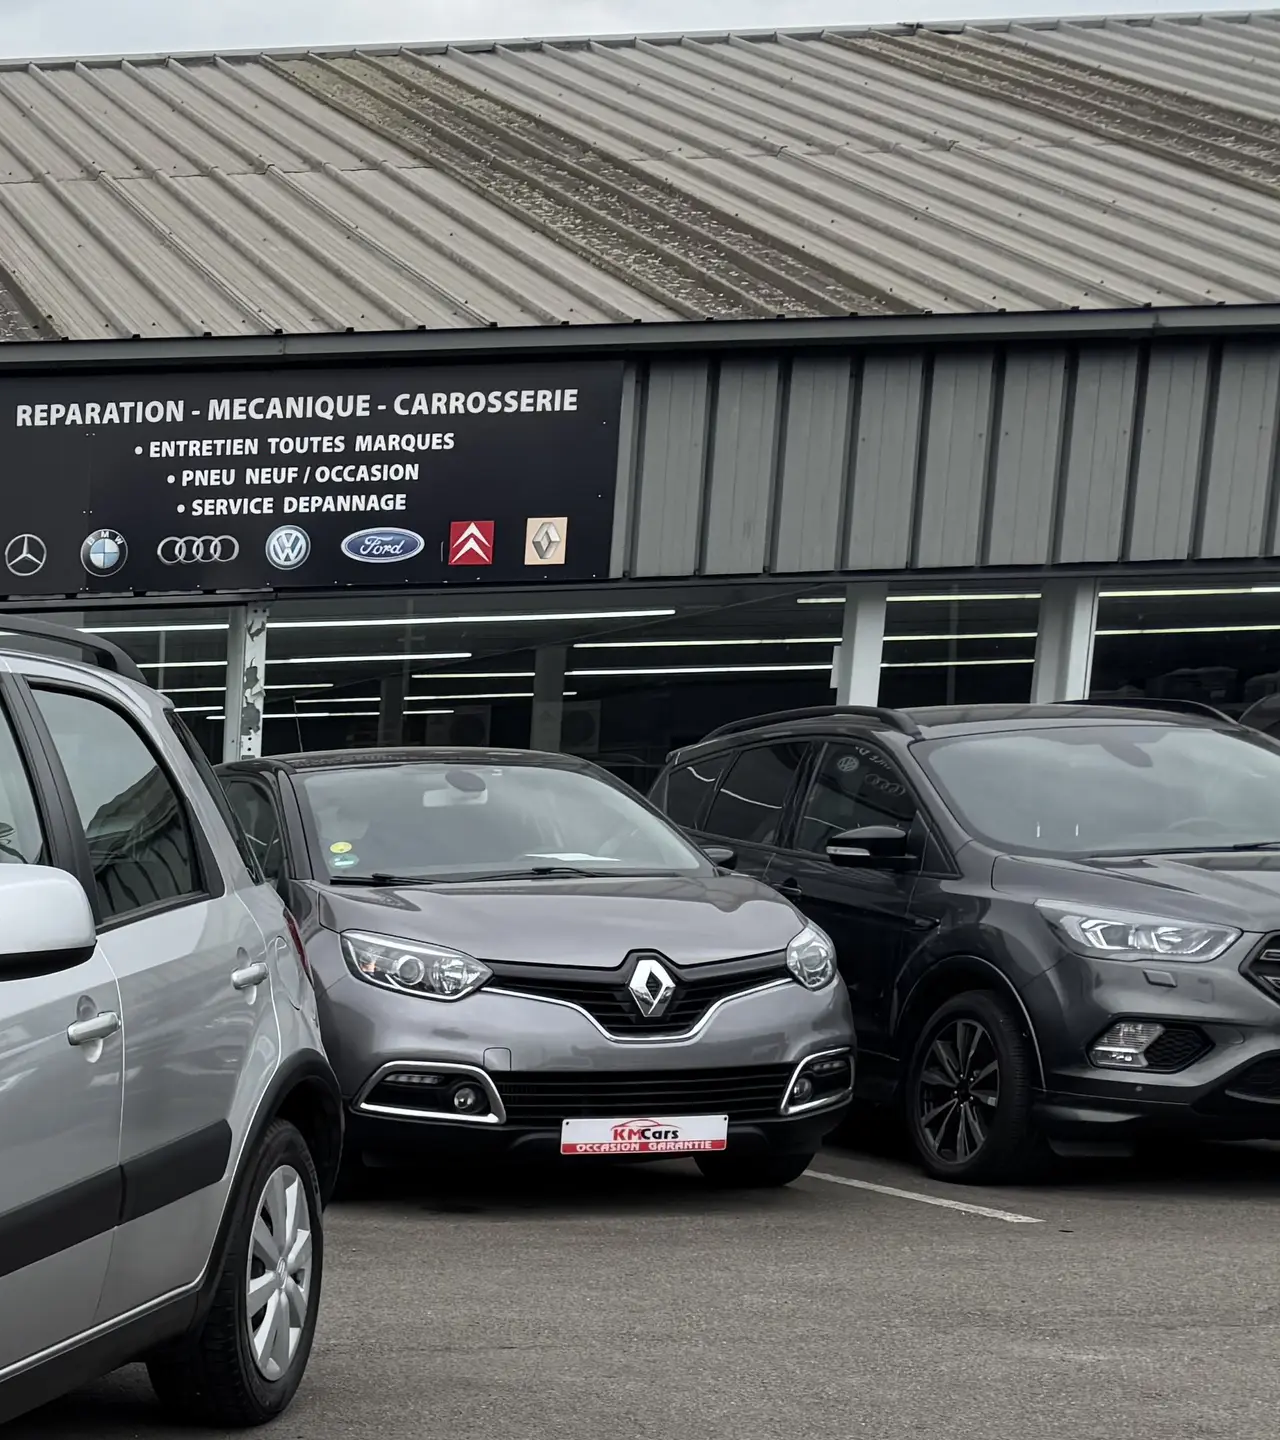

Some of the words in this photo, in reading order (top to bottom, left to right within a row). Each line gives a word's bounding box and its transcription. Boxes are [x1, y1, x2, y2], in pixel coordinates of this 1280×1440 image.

[16, 399, 185, 427] REPARATION
[207, 394, 371, 421] MECANIQUE
[393, 388, 579, 416] CARROSSERIE
[149, 438, 259, 458] ENTRETIEN
[267, 435, 346, 455] TOUTES
[354, 432, 455, 452] MARQUES
[181, 468, 236, 487] PNEU
[245, 466, 299, 485] NEUF
[314, 463, 420, 483] OCCASION
[191, 497, 274, 517] SERVICE
[283, 493, 407, 514] DEPANNAGE
[359, 535, 403, 557] Ford
[576, 1142, 640, 1152] OCCASION
[648, 1140, 712, 1151] GARANTIE
[613, 1127, 680, 1141] KMCars
